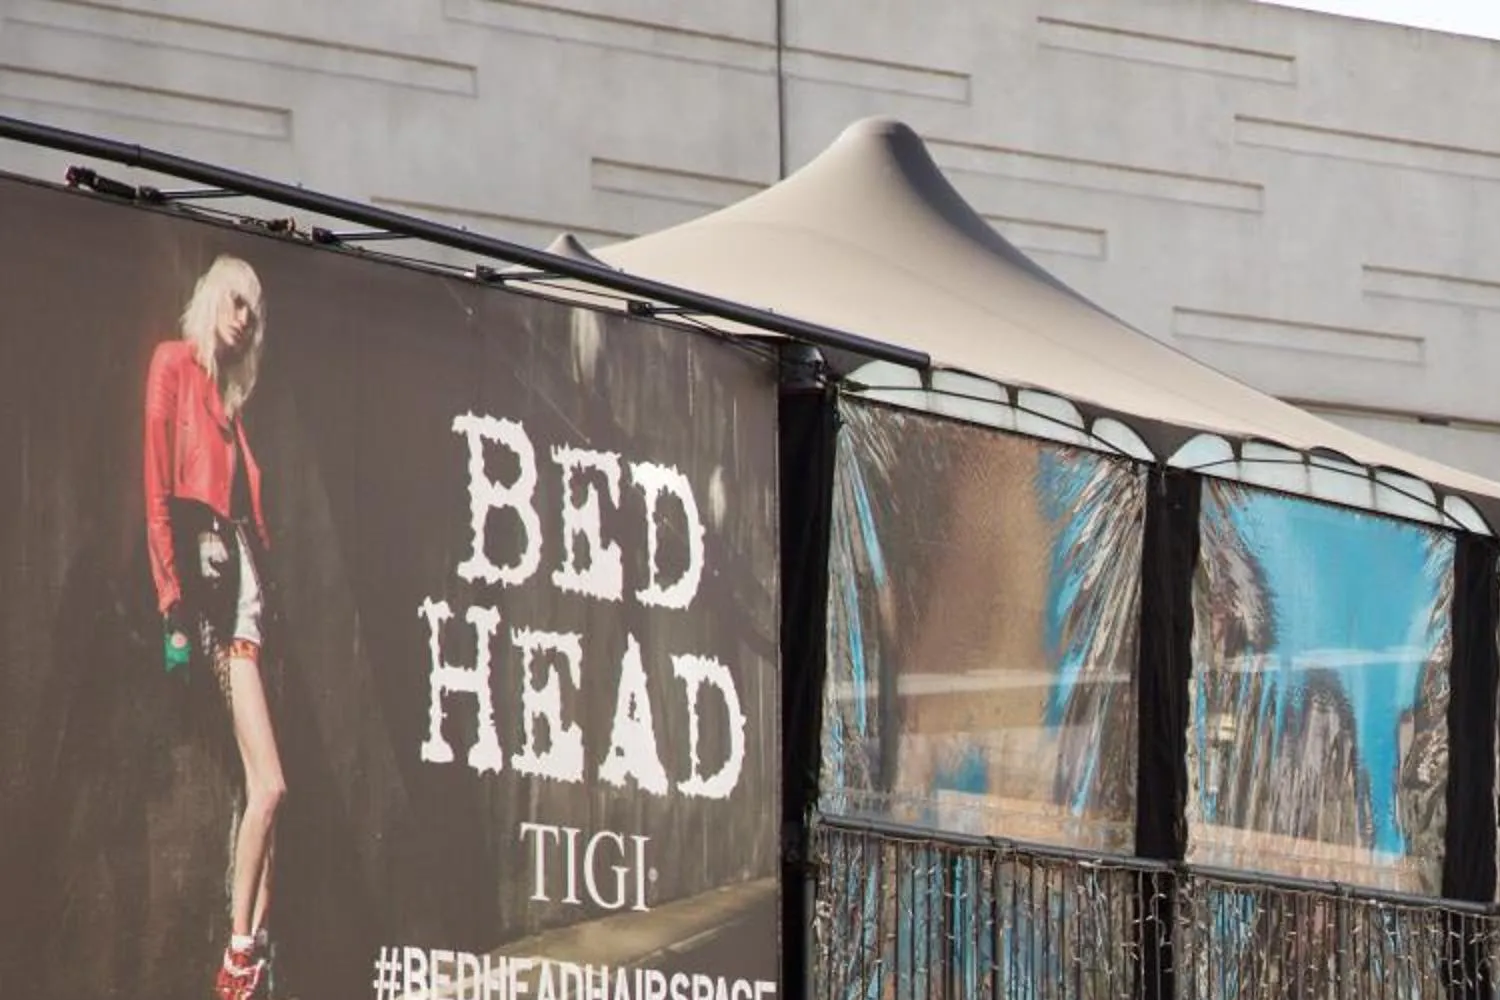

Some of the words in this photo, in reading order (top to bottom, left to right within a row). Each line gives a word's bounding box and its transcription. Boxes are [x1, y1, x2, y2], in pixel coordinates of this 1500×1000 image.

[452, 411, 705, 610] BED
[418, 596, 746, 800] HEAD
[520, 822, 652, 912] TIGI
